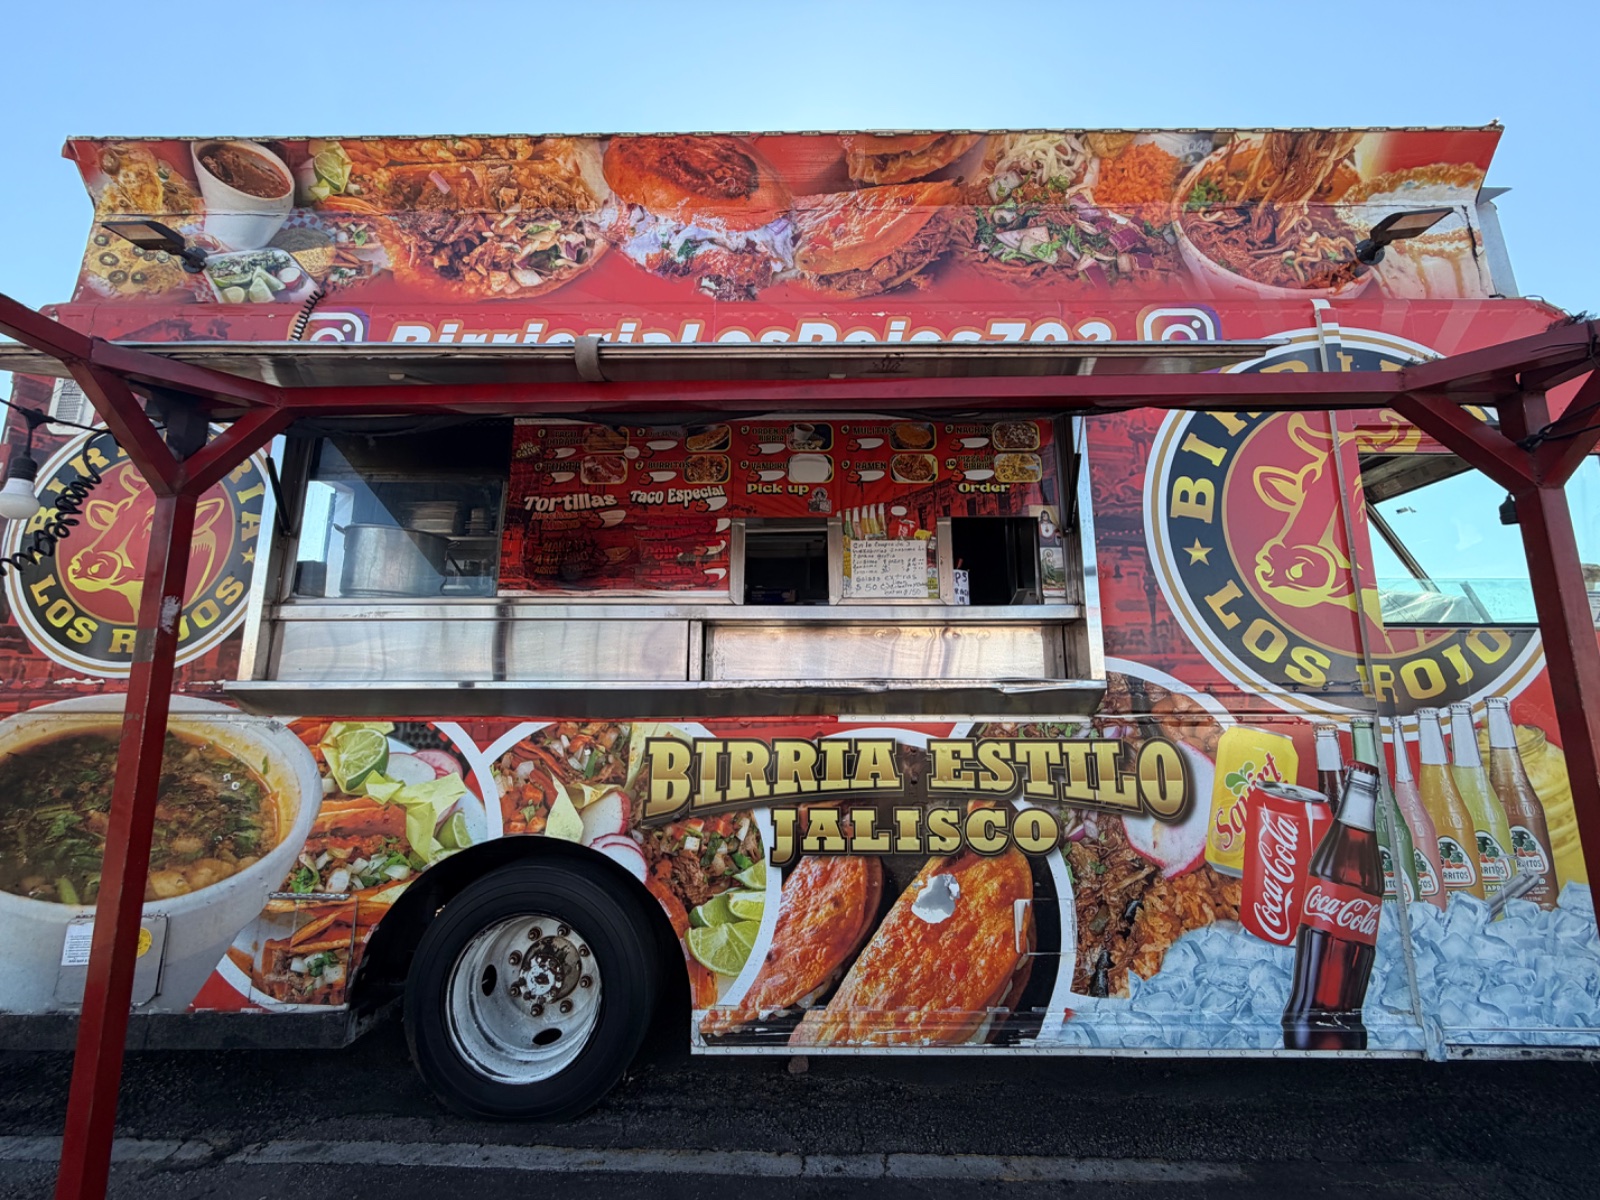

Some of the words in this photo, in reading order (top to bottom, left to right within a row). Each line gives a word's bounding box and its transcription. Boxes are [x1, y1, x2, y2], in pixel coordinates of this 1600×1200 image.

[853, 426, 896, 435] MULITOS
[956, 425, 993, 434] NACHOS
[648, 461, 691, 469] BURRITOS
[855, 462, 887, 470] RAMEN
[26, 429, 262, 541] BIRRIA
[630, 490, 664, 505] Taco
[667, 485, 726, 508] Especial
[747, 484, 783, 494] Pick
[788, 484, 810, 496] up
[958, 483, 1011, 493] Order
[523, 493, 618, 512] Tortillas
[30, 574, 99, 644] LOS
[108, 576, 244, 654] RJOS
[1204, 579, 1332, 688] LOS
[647, 738, 902, 821] BIRRIA
[928, 738, 1189, 819] ESTILO
[771, 807, 1060, 865] JALISCO
[1254, 803, 1299, 940] Coca-Cola
[1304, 885, 1380, 935] Coca-Cola
